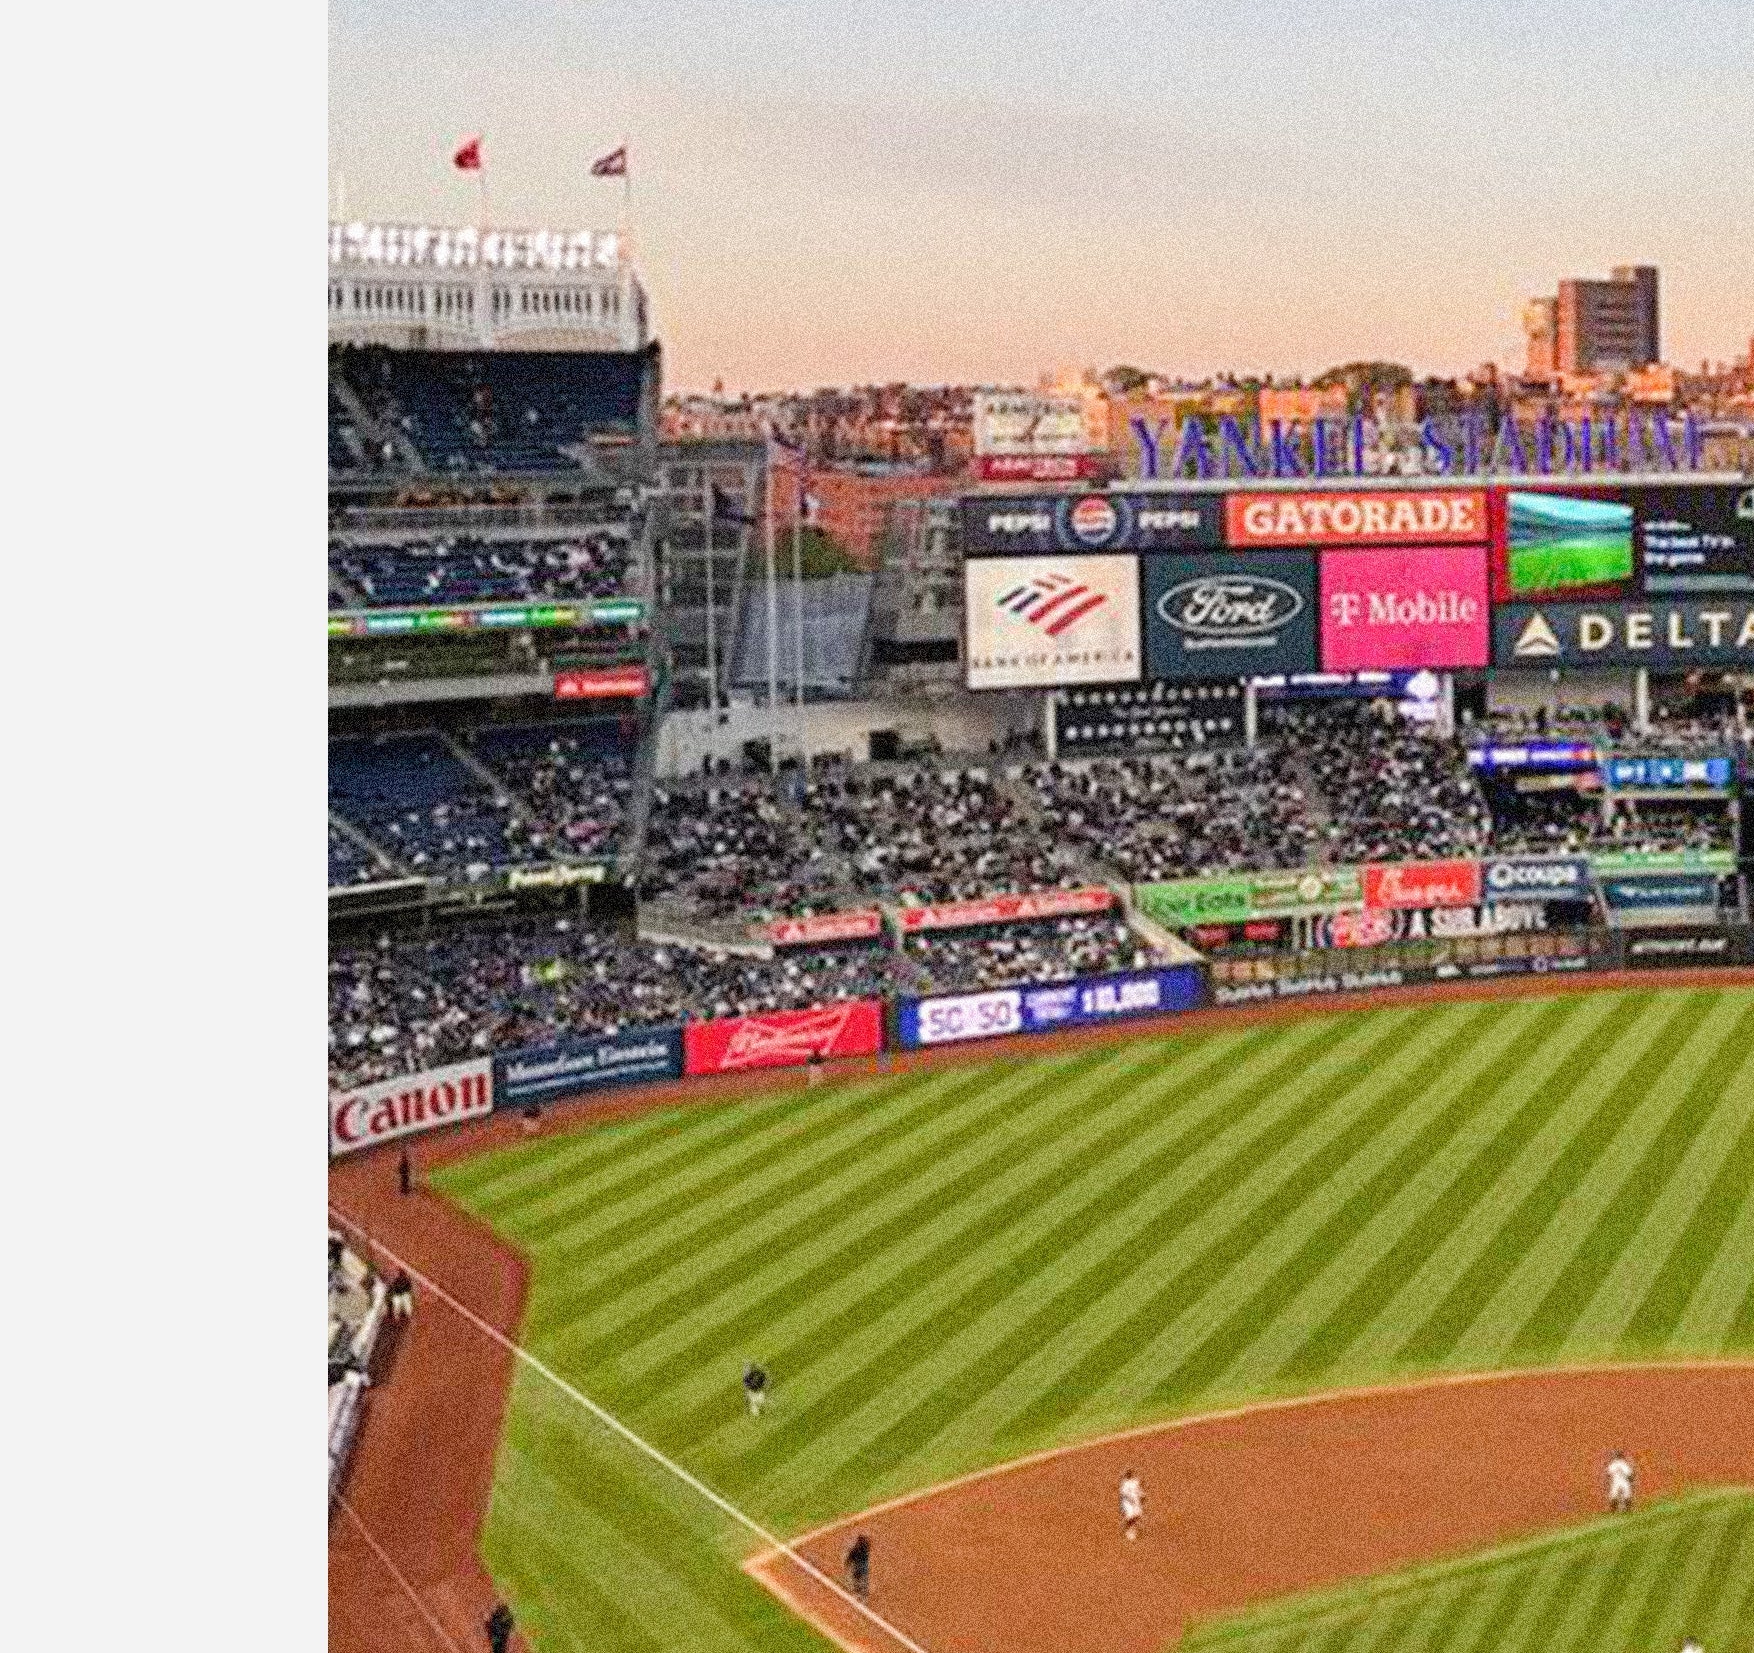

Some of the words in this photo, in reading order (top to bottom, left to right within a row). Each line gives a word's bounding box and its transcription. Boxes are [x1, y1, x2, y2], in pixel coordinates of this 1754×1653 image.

[1420, 412, 1703, 477] STADIUM
[987, 512, 1051, 531] PEPSI
[1138, 512, 1199, 528] PEPSI
[1244, 498, 1475, 535] GATORADE
[1369, 592, 1478, 624] Mobile
[334, 1074, 490, 1143] Canon
